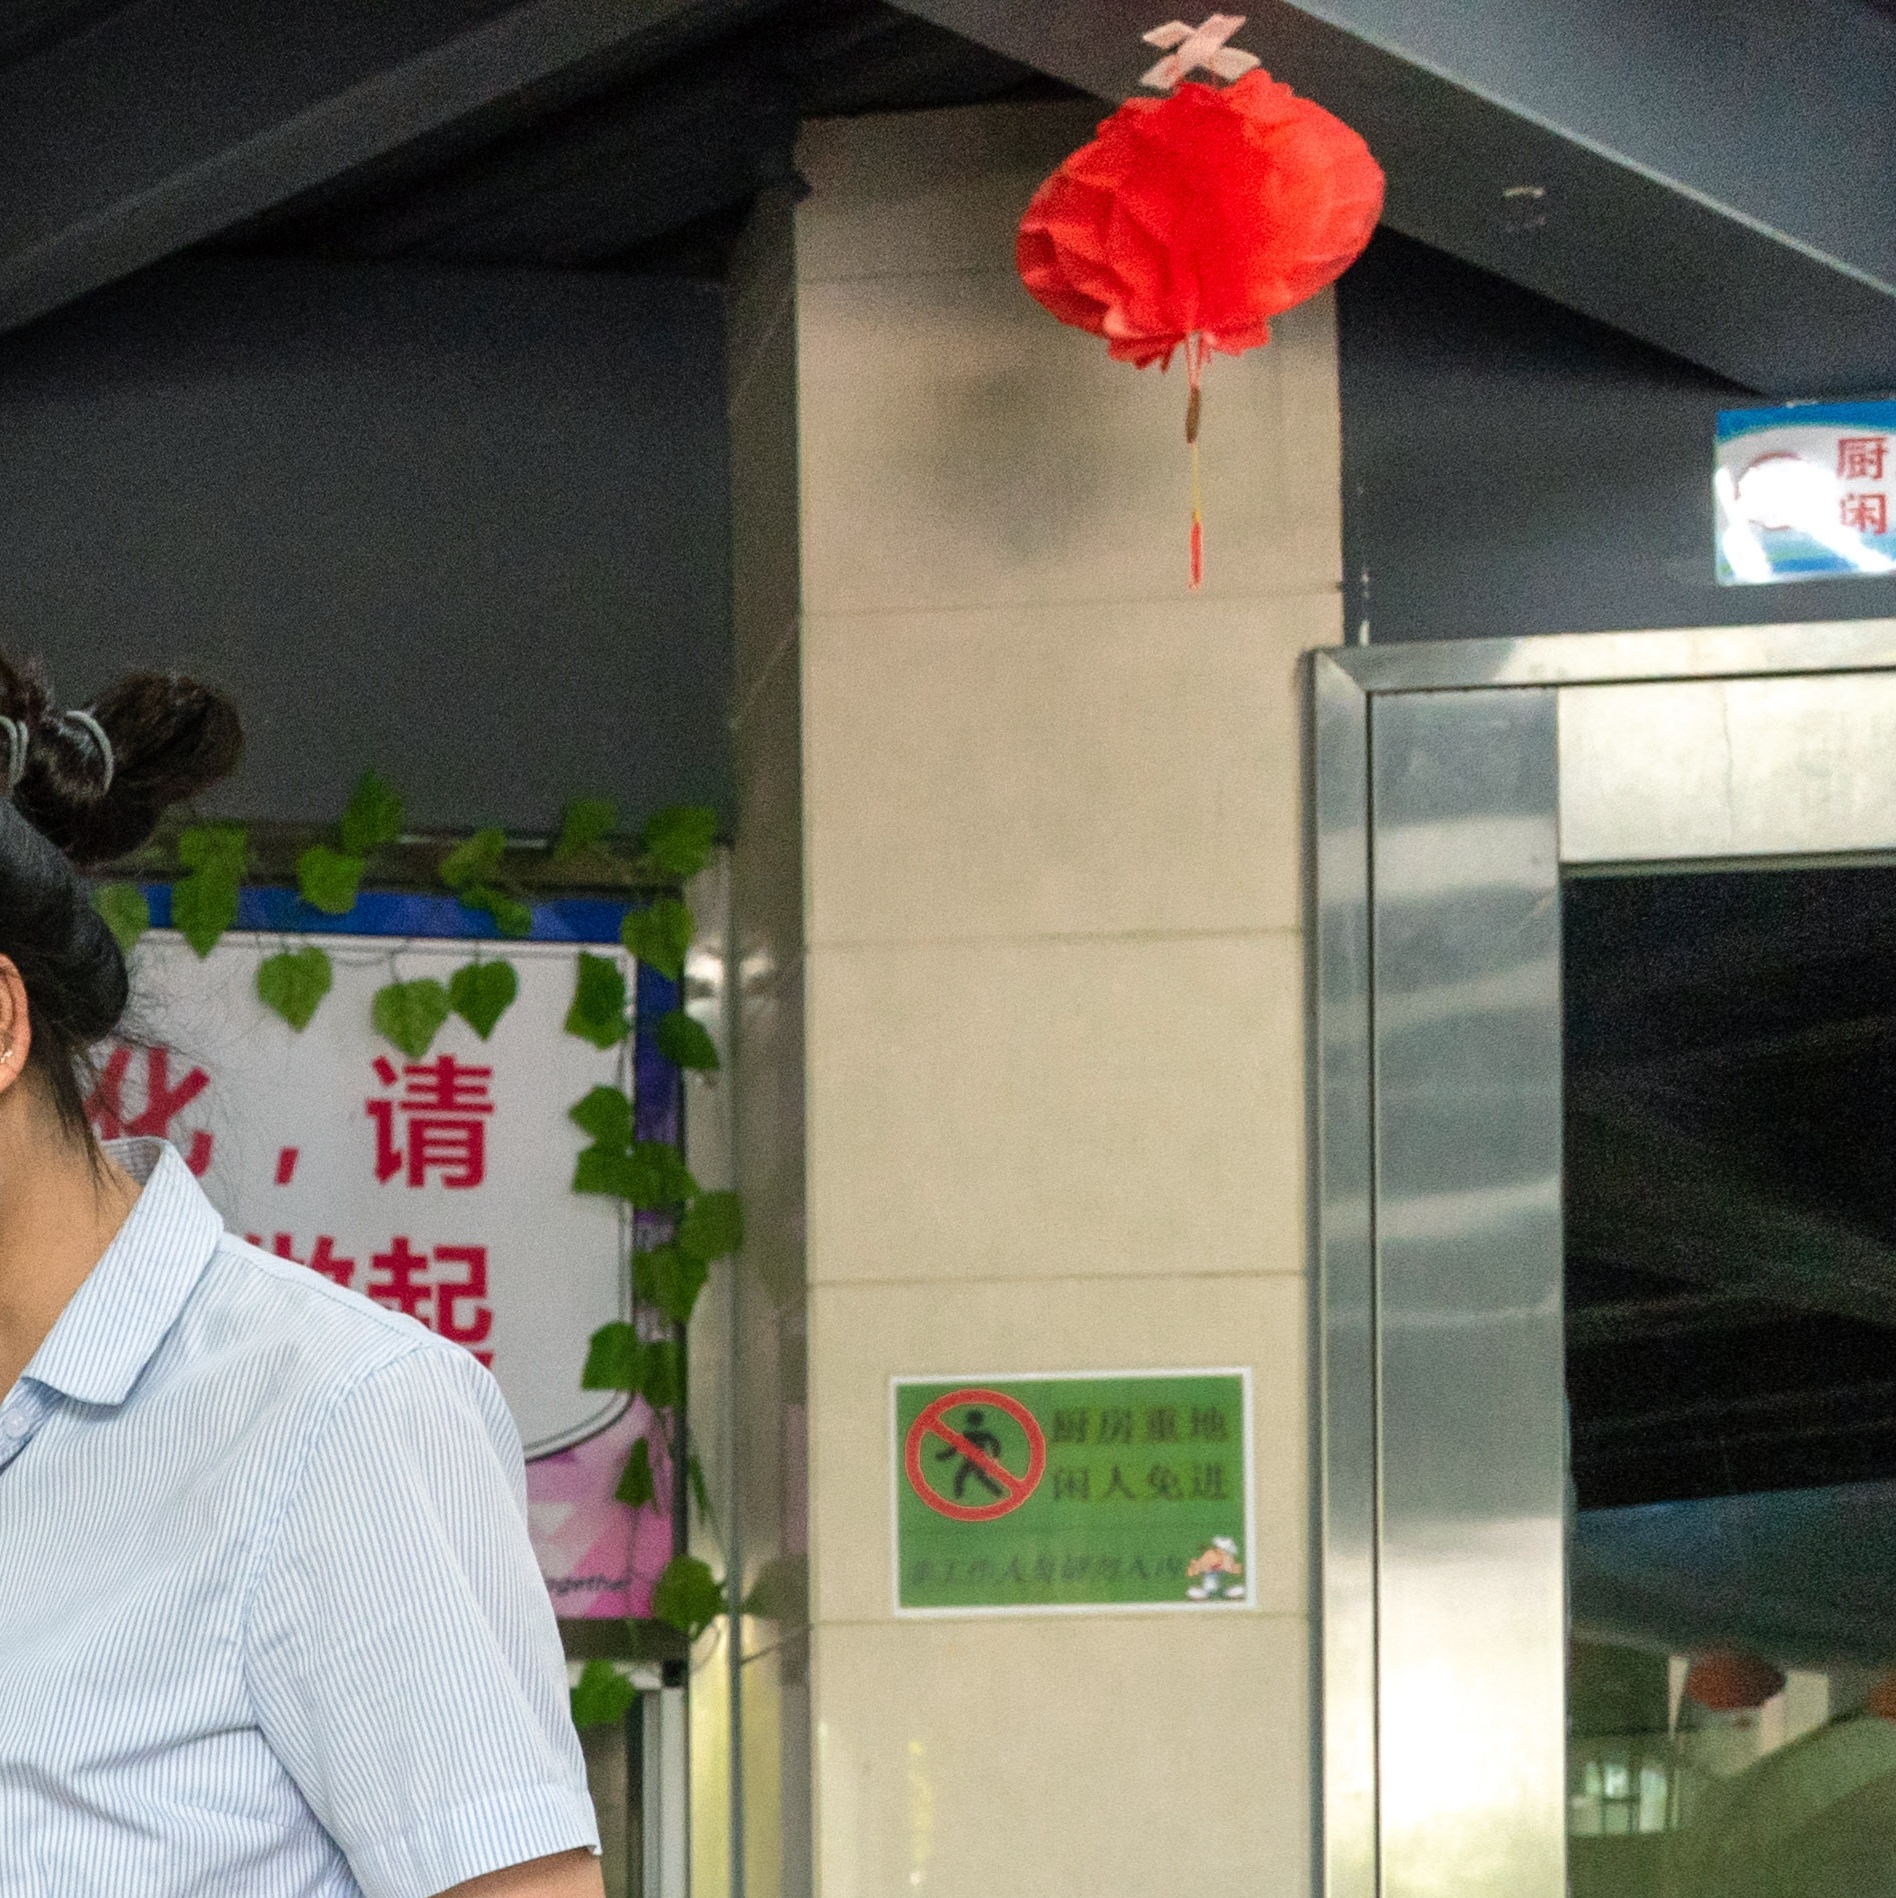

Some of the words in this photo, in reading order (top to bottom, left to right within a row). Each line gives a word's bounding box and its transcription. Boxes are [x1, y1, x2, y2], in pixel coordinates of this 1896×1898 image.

[1051, 1404, 1229, 1445] 厨房重地
[1051, 1461, 1229, 1502] 闲人免进
